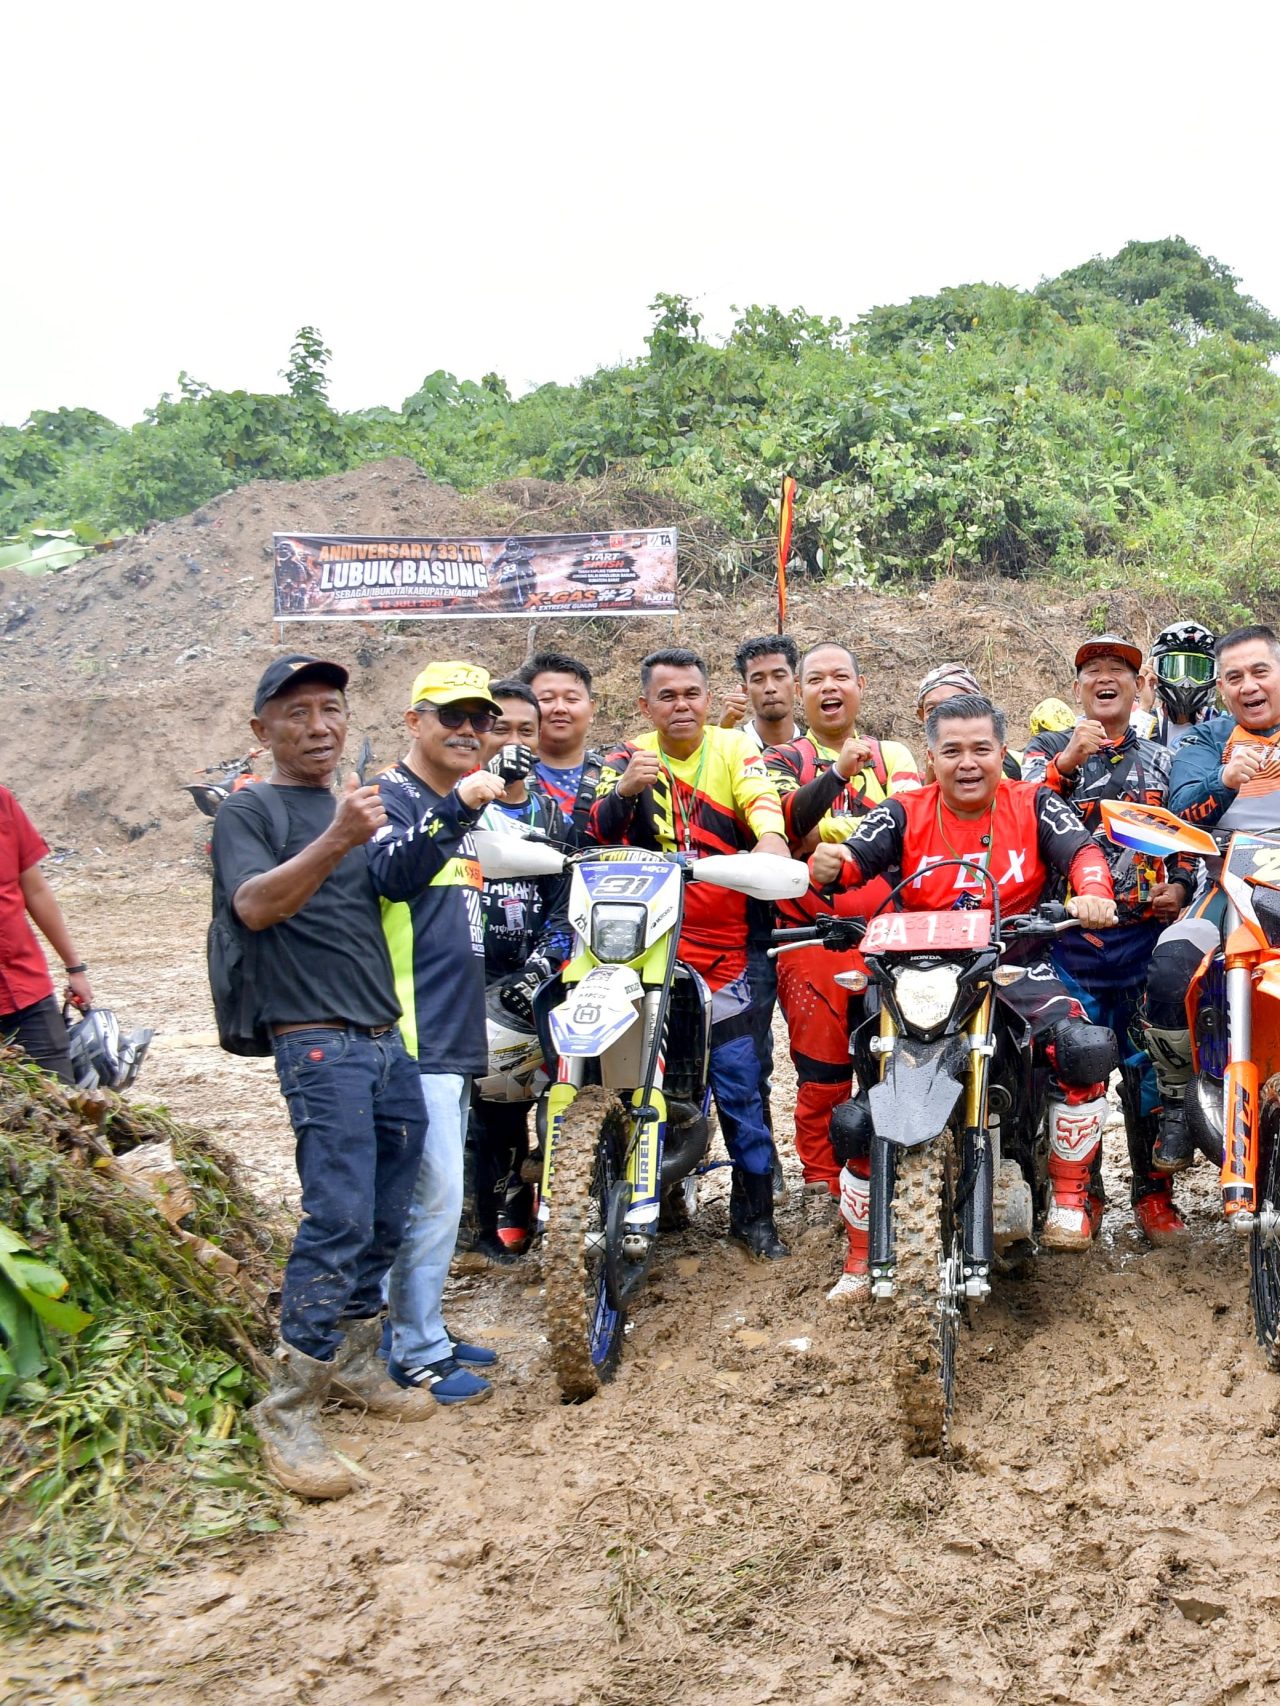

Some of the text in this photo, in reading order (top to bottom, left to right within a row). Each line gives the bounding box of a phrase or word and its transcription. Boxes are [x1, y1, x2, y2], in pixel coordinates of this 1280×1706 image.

[319, 544, 482, 562] ANNIVERSARY 33 TH
[582, 553, 620, 561] START
[583, 560, 624, 568] FINISH
[321, 560, 488, 589] LUBUK BASUNG
[334, 587, 478, 600] SEBAGAI IBUKOTA KABUPATEN AGAM
[523, 588, 634, 608] X-GAS #2
[1119, 809, 1182, 835] KTM
[911, 848, 1027, 889] FOX
[592, 875, 653, 896] 31
[867, 912, 985, 946] BA 1 T
